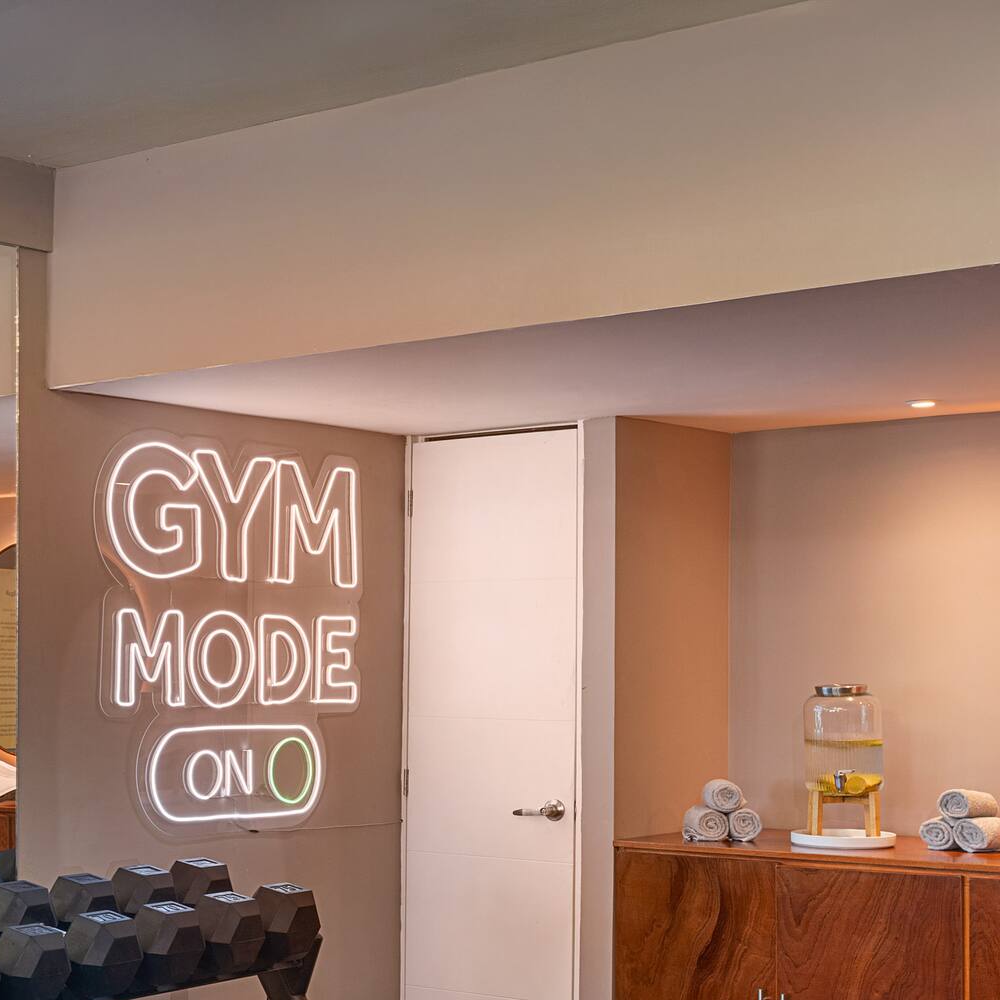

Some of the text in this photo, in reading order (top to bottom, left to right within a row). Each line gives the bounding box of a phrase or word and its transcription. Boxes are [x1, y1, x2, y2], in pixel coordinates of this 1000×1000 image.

[106, 441, 358, 588] GYM
[114, 607, 358, 709] MODE
[186, 748, 254, 800] ON
